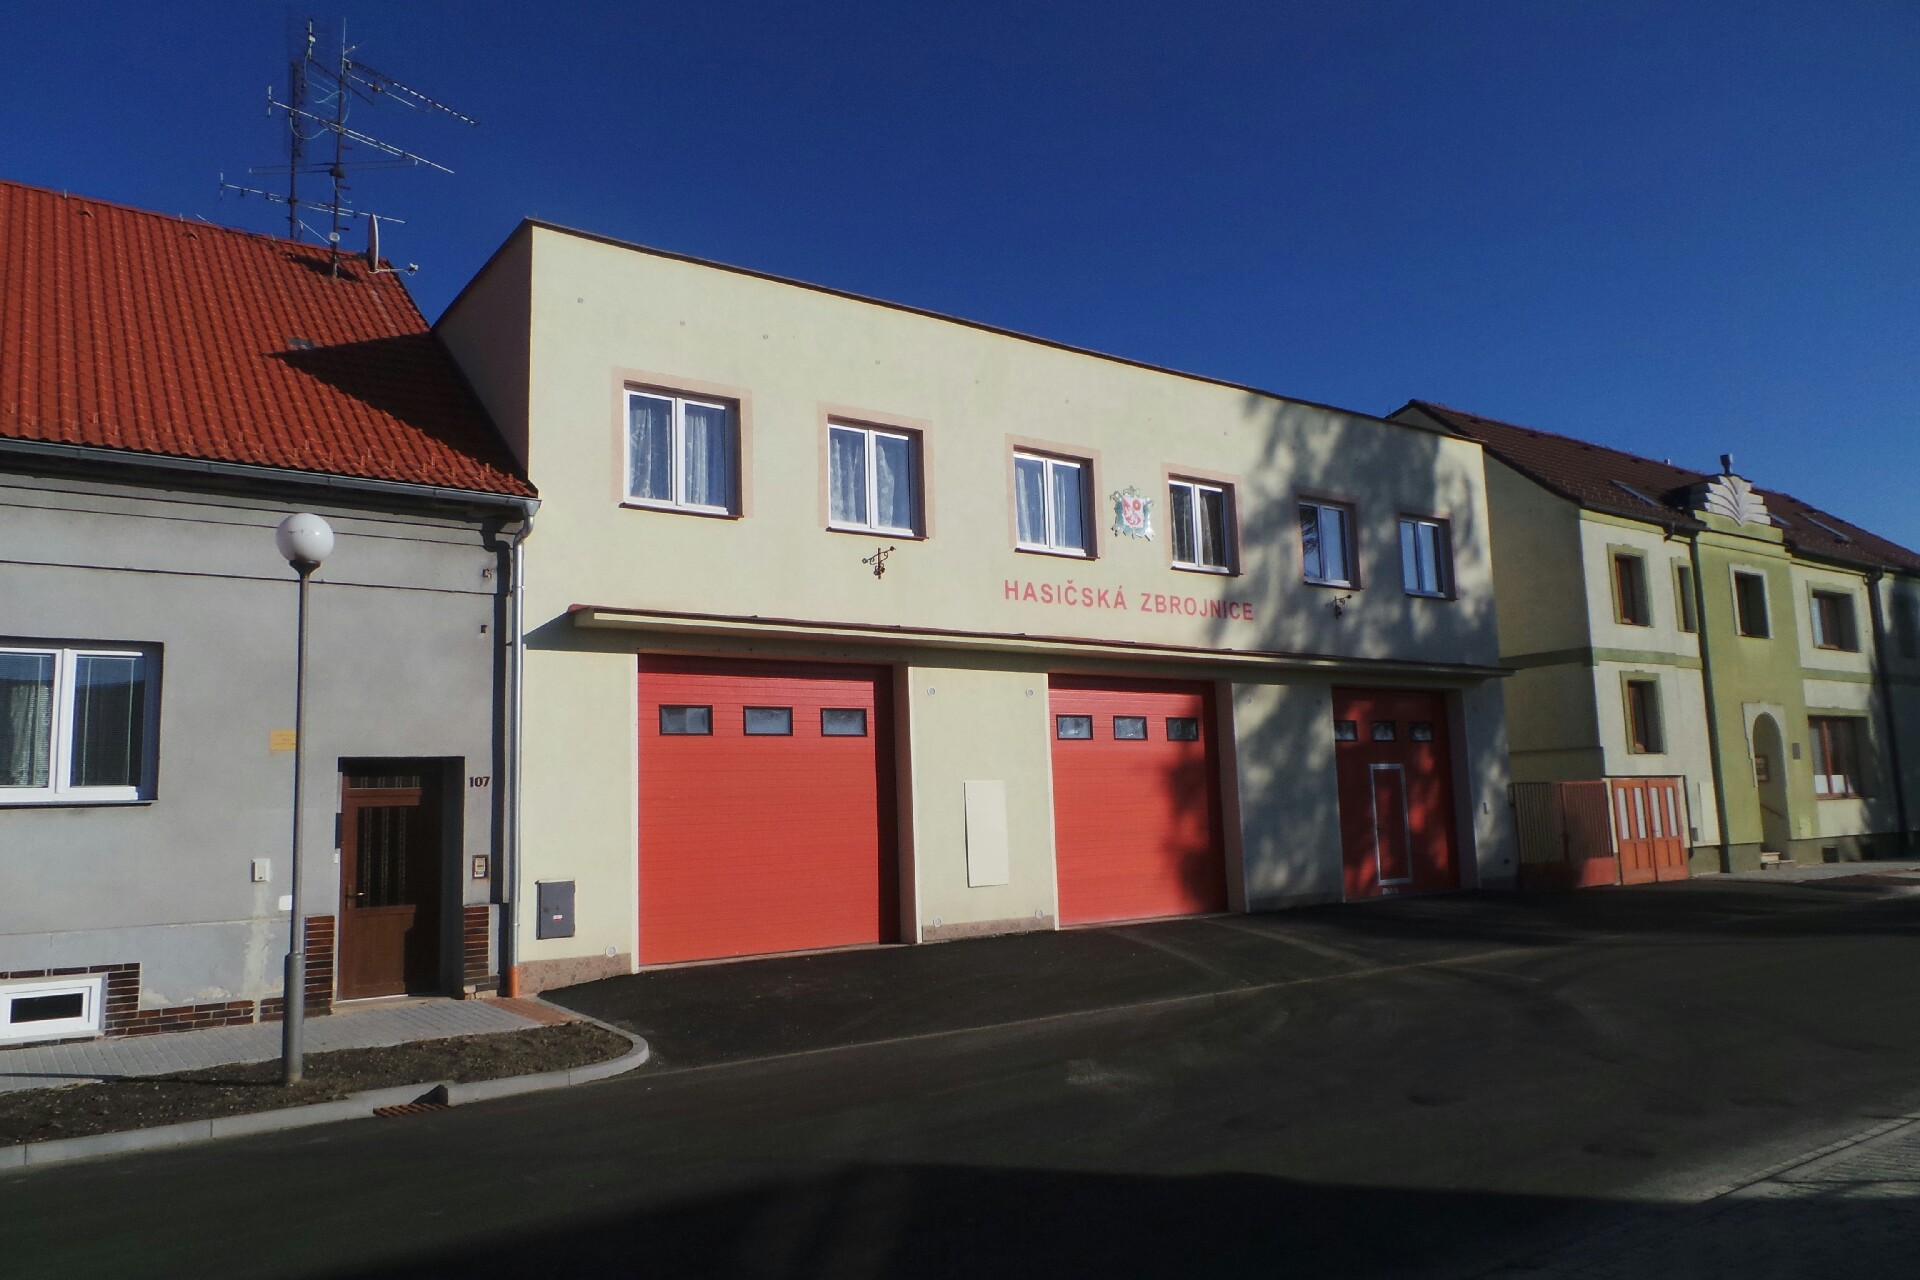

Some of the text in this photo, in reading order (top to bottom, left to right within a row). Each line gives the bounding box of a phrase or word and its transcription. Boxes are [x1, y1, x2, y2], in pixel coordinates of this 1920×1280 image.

[1004, 579, 1254, 621] HASIČSKÁ ZBROJNICE
[469, 776, 490, 788] 107
